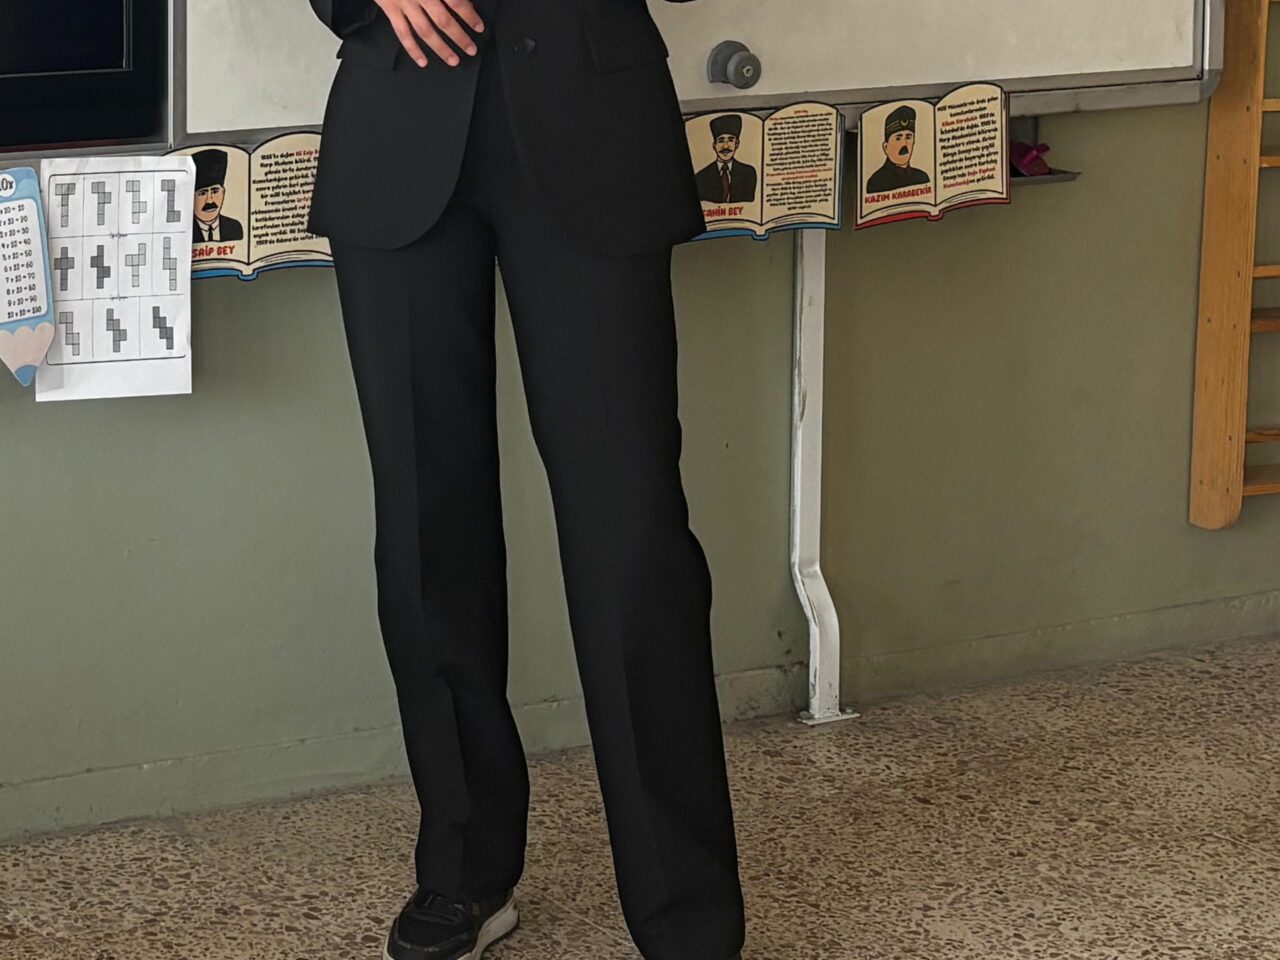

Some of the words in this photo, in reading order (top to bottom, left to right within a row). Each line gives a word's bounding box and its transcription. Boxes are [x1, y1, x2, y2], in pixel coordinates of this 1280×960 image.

[865, 193, 889, 203] KAZIM
[729, 206, 743, 216] BEY
[217, 245, 235, 255] BEY
